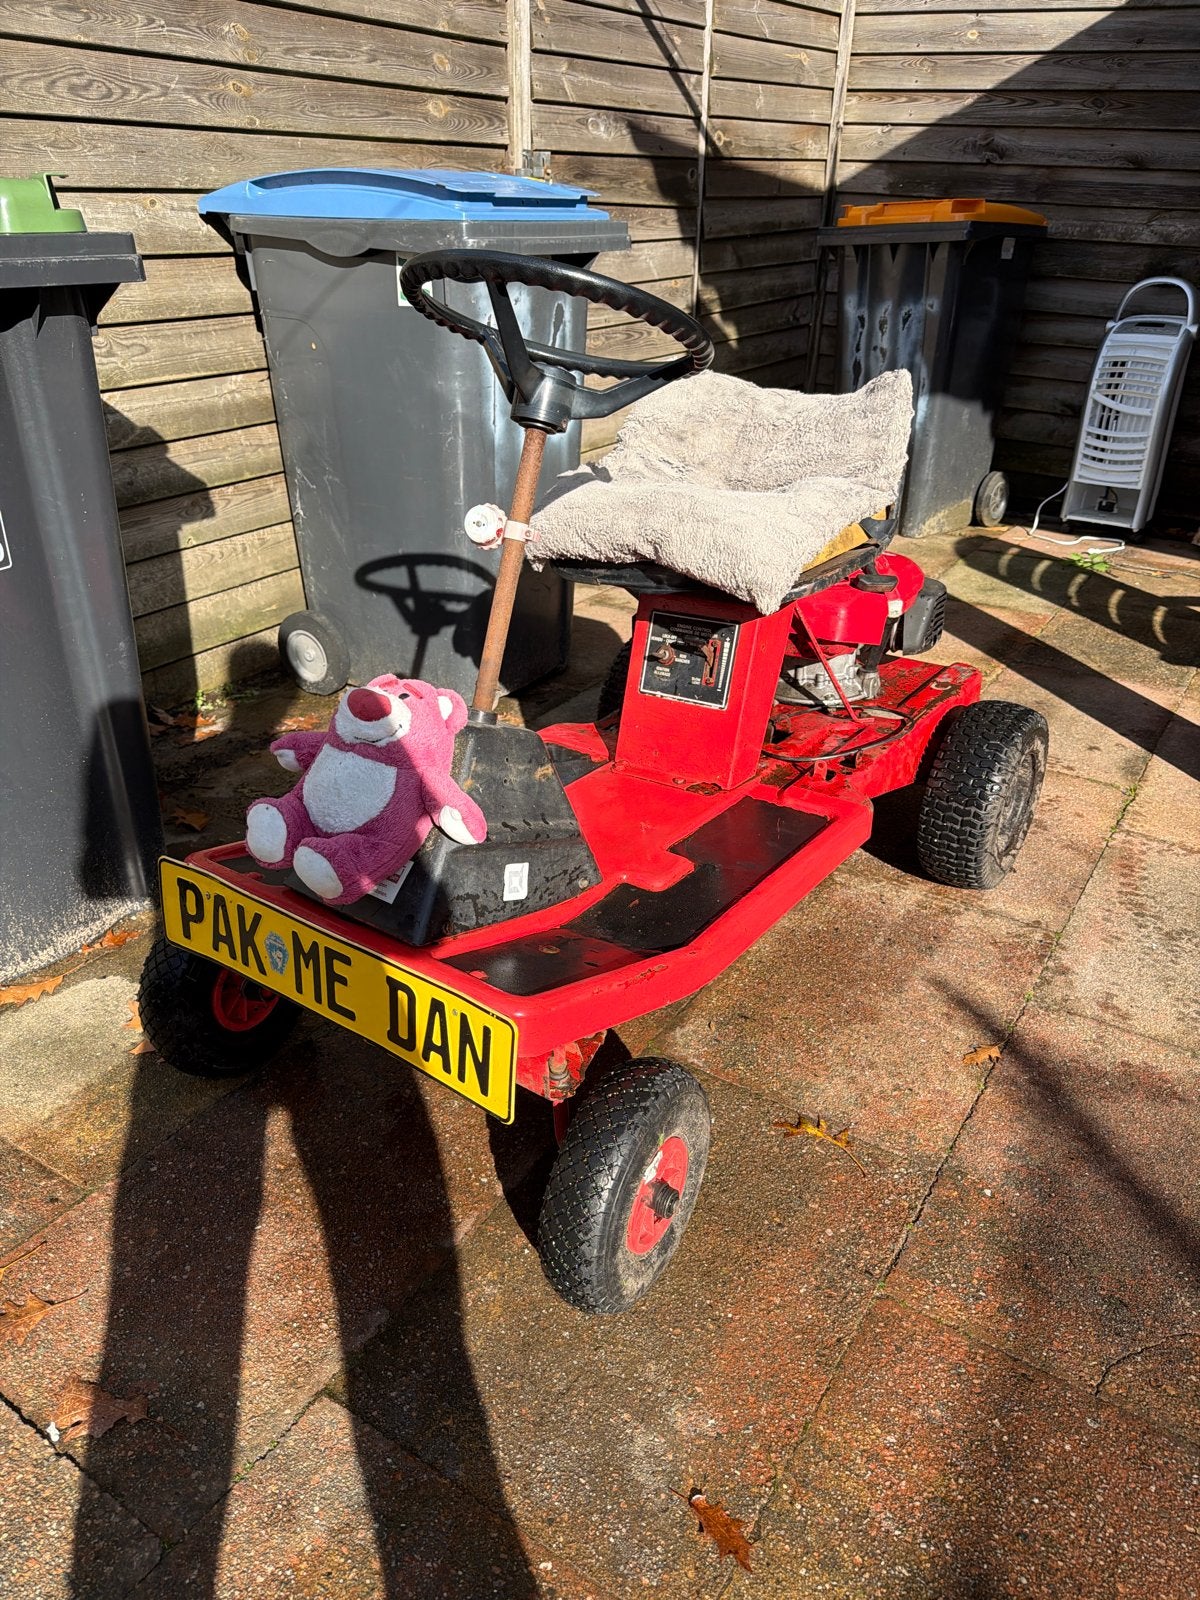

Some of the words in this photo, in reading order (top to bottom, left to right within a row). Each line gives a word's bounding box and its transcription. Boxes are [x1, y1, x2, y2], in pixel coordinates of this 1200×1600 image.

[177, 877, 266, 976] PAK
[292, 931, 356, 1021] ME
[386, 976, 491, 1097] DAN
